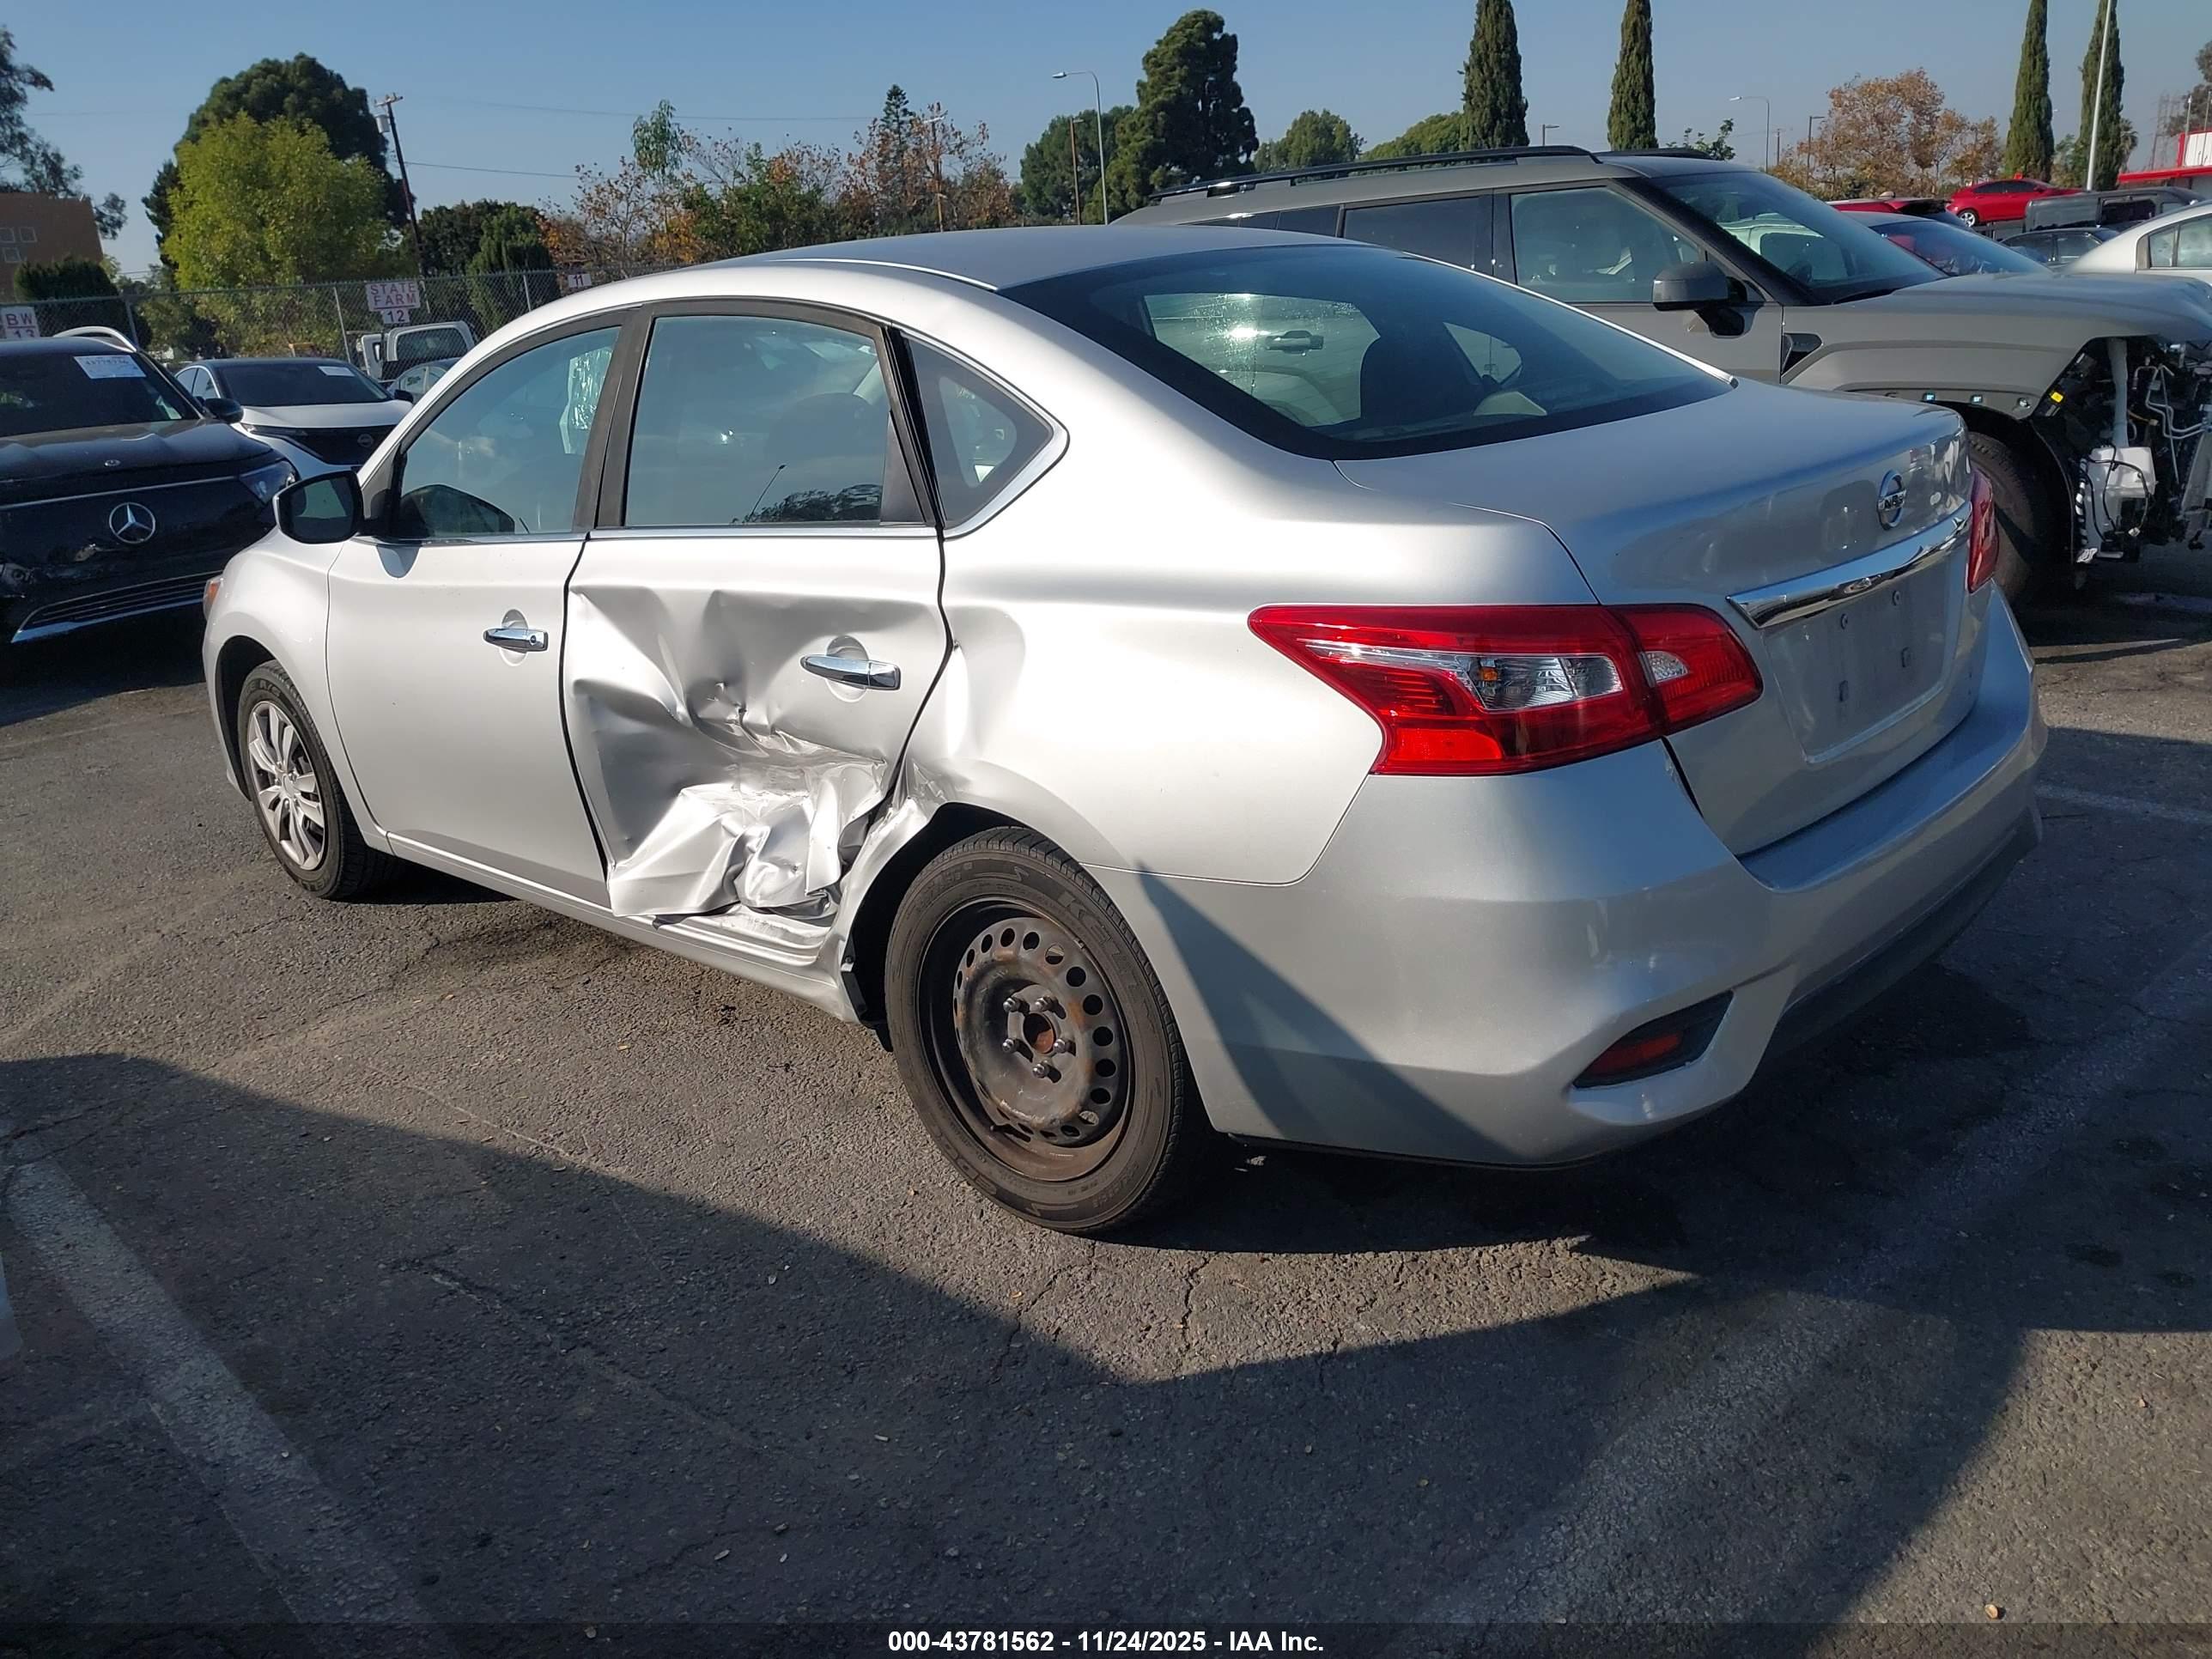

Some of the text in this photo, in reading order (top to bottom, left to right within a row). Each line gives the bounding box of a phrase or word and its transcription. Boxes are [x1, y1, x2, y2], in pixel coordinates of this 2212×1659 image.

[573, 274, 584, 286] 11
[370, 282, 416, 295] STATE
[374, 294, 416, 306] FARM
[387, 309, 405, 322] 12
